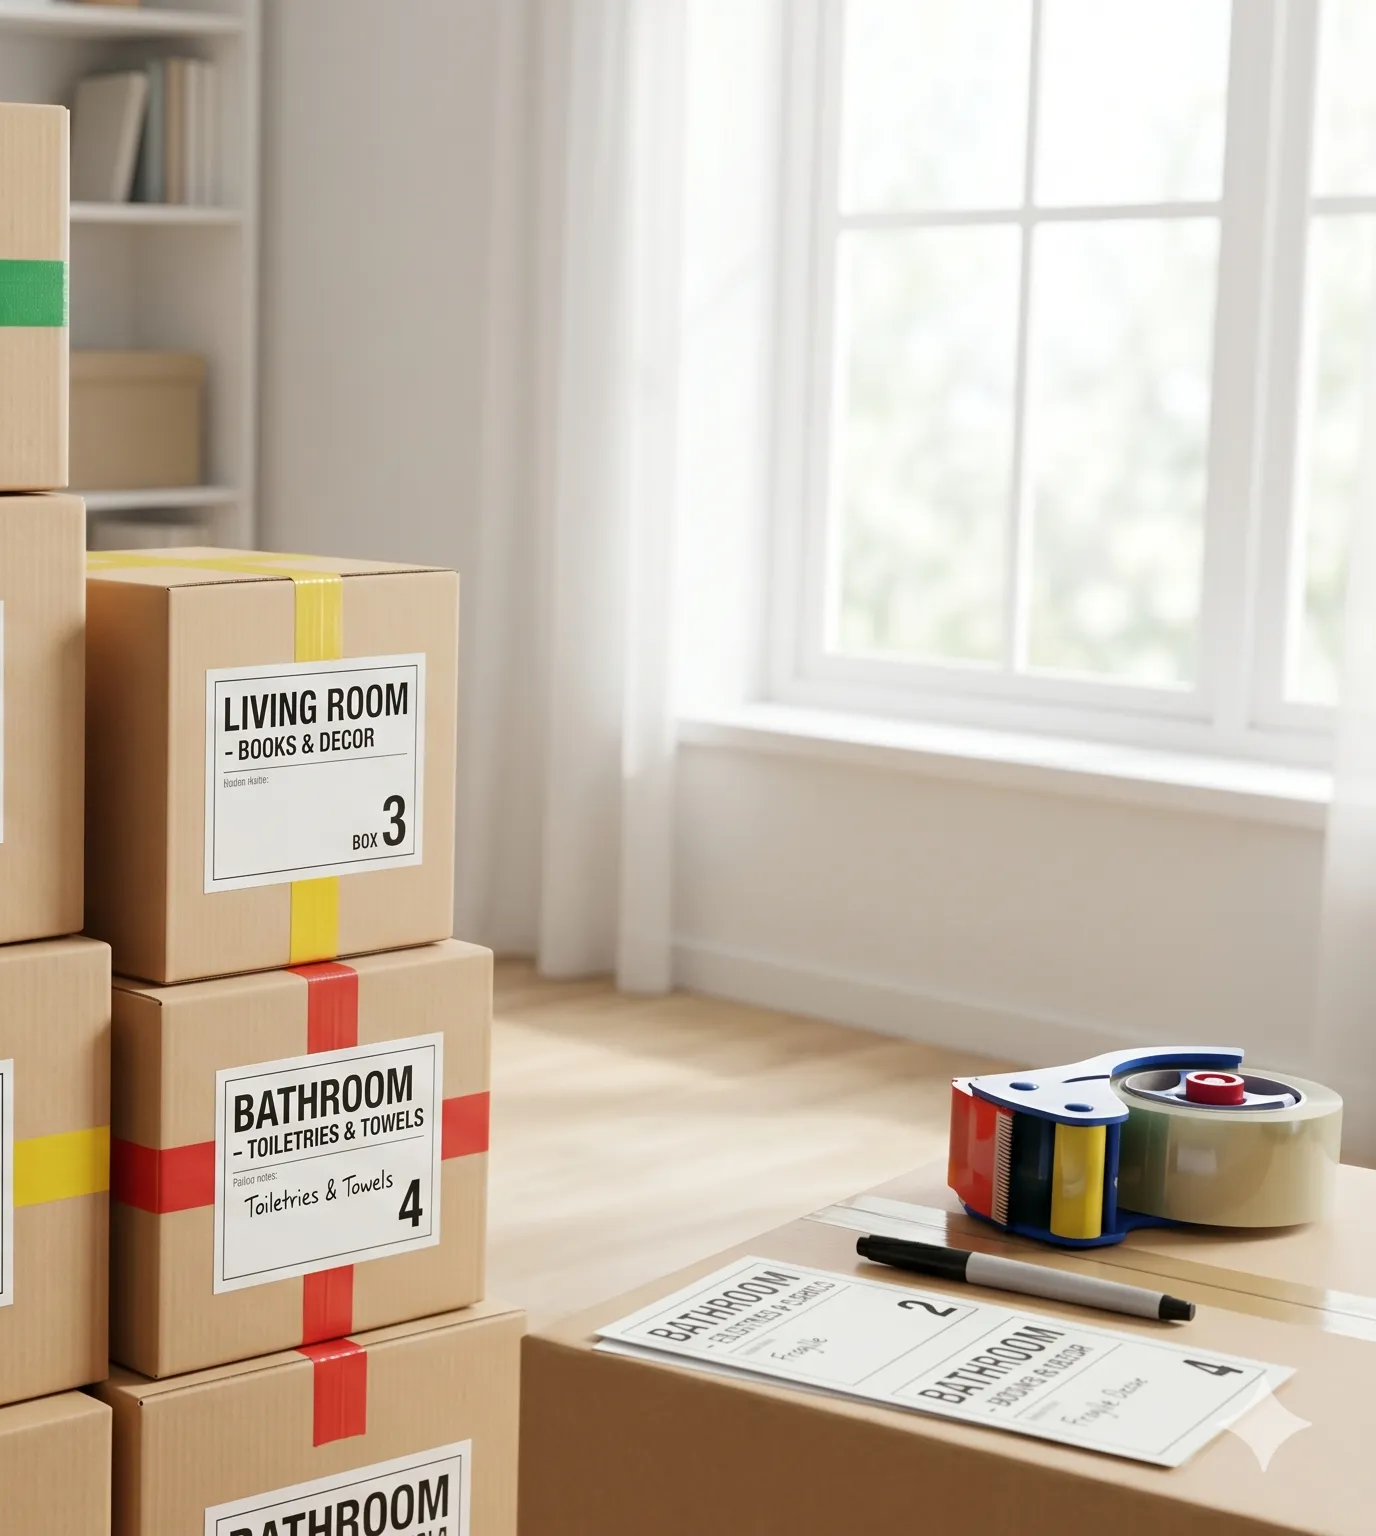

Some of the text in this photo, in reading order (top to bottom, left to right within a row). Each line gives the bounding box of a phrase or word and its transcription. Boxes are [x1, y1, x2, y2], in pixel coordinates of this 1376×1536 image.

[224, 682, 408, 732] LIVING ROOM
[238, 735, 297, 761] BOOKS
[301, 733, 314, 754] &
[319, 727, 375, 753] DECOR
[352, 794, 406, 850] BOX 3
[234, 1065, 413, 1133] BATHROOM
[247, 1123, 340, 1159] TOILETRIES
[344, 1121, 356, 1140] &
[360, 1107, 424, 1137] TOWELS
[244, 1169, 394, 1218] Toiletries & Towels
[257, 1172, 278, 1183] notes:
[398, 1178, 423, 1228] 4
[647, 1270, 800, 1342] BATHROOM
[897, 1300, 958, 1318] 2
[918, 1325, 1065, 1404] BATHROOM
[1182, 1359, 1244, 1377] 4
[229, 1474, 449, 1536] THROOM
